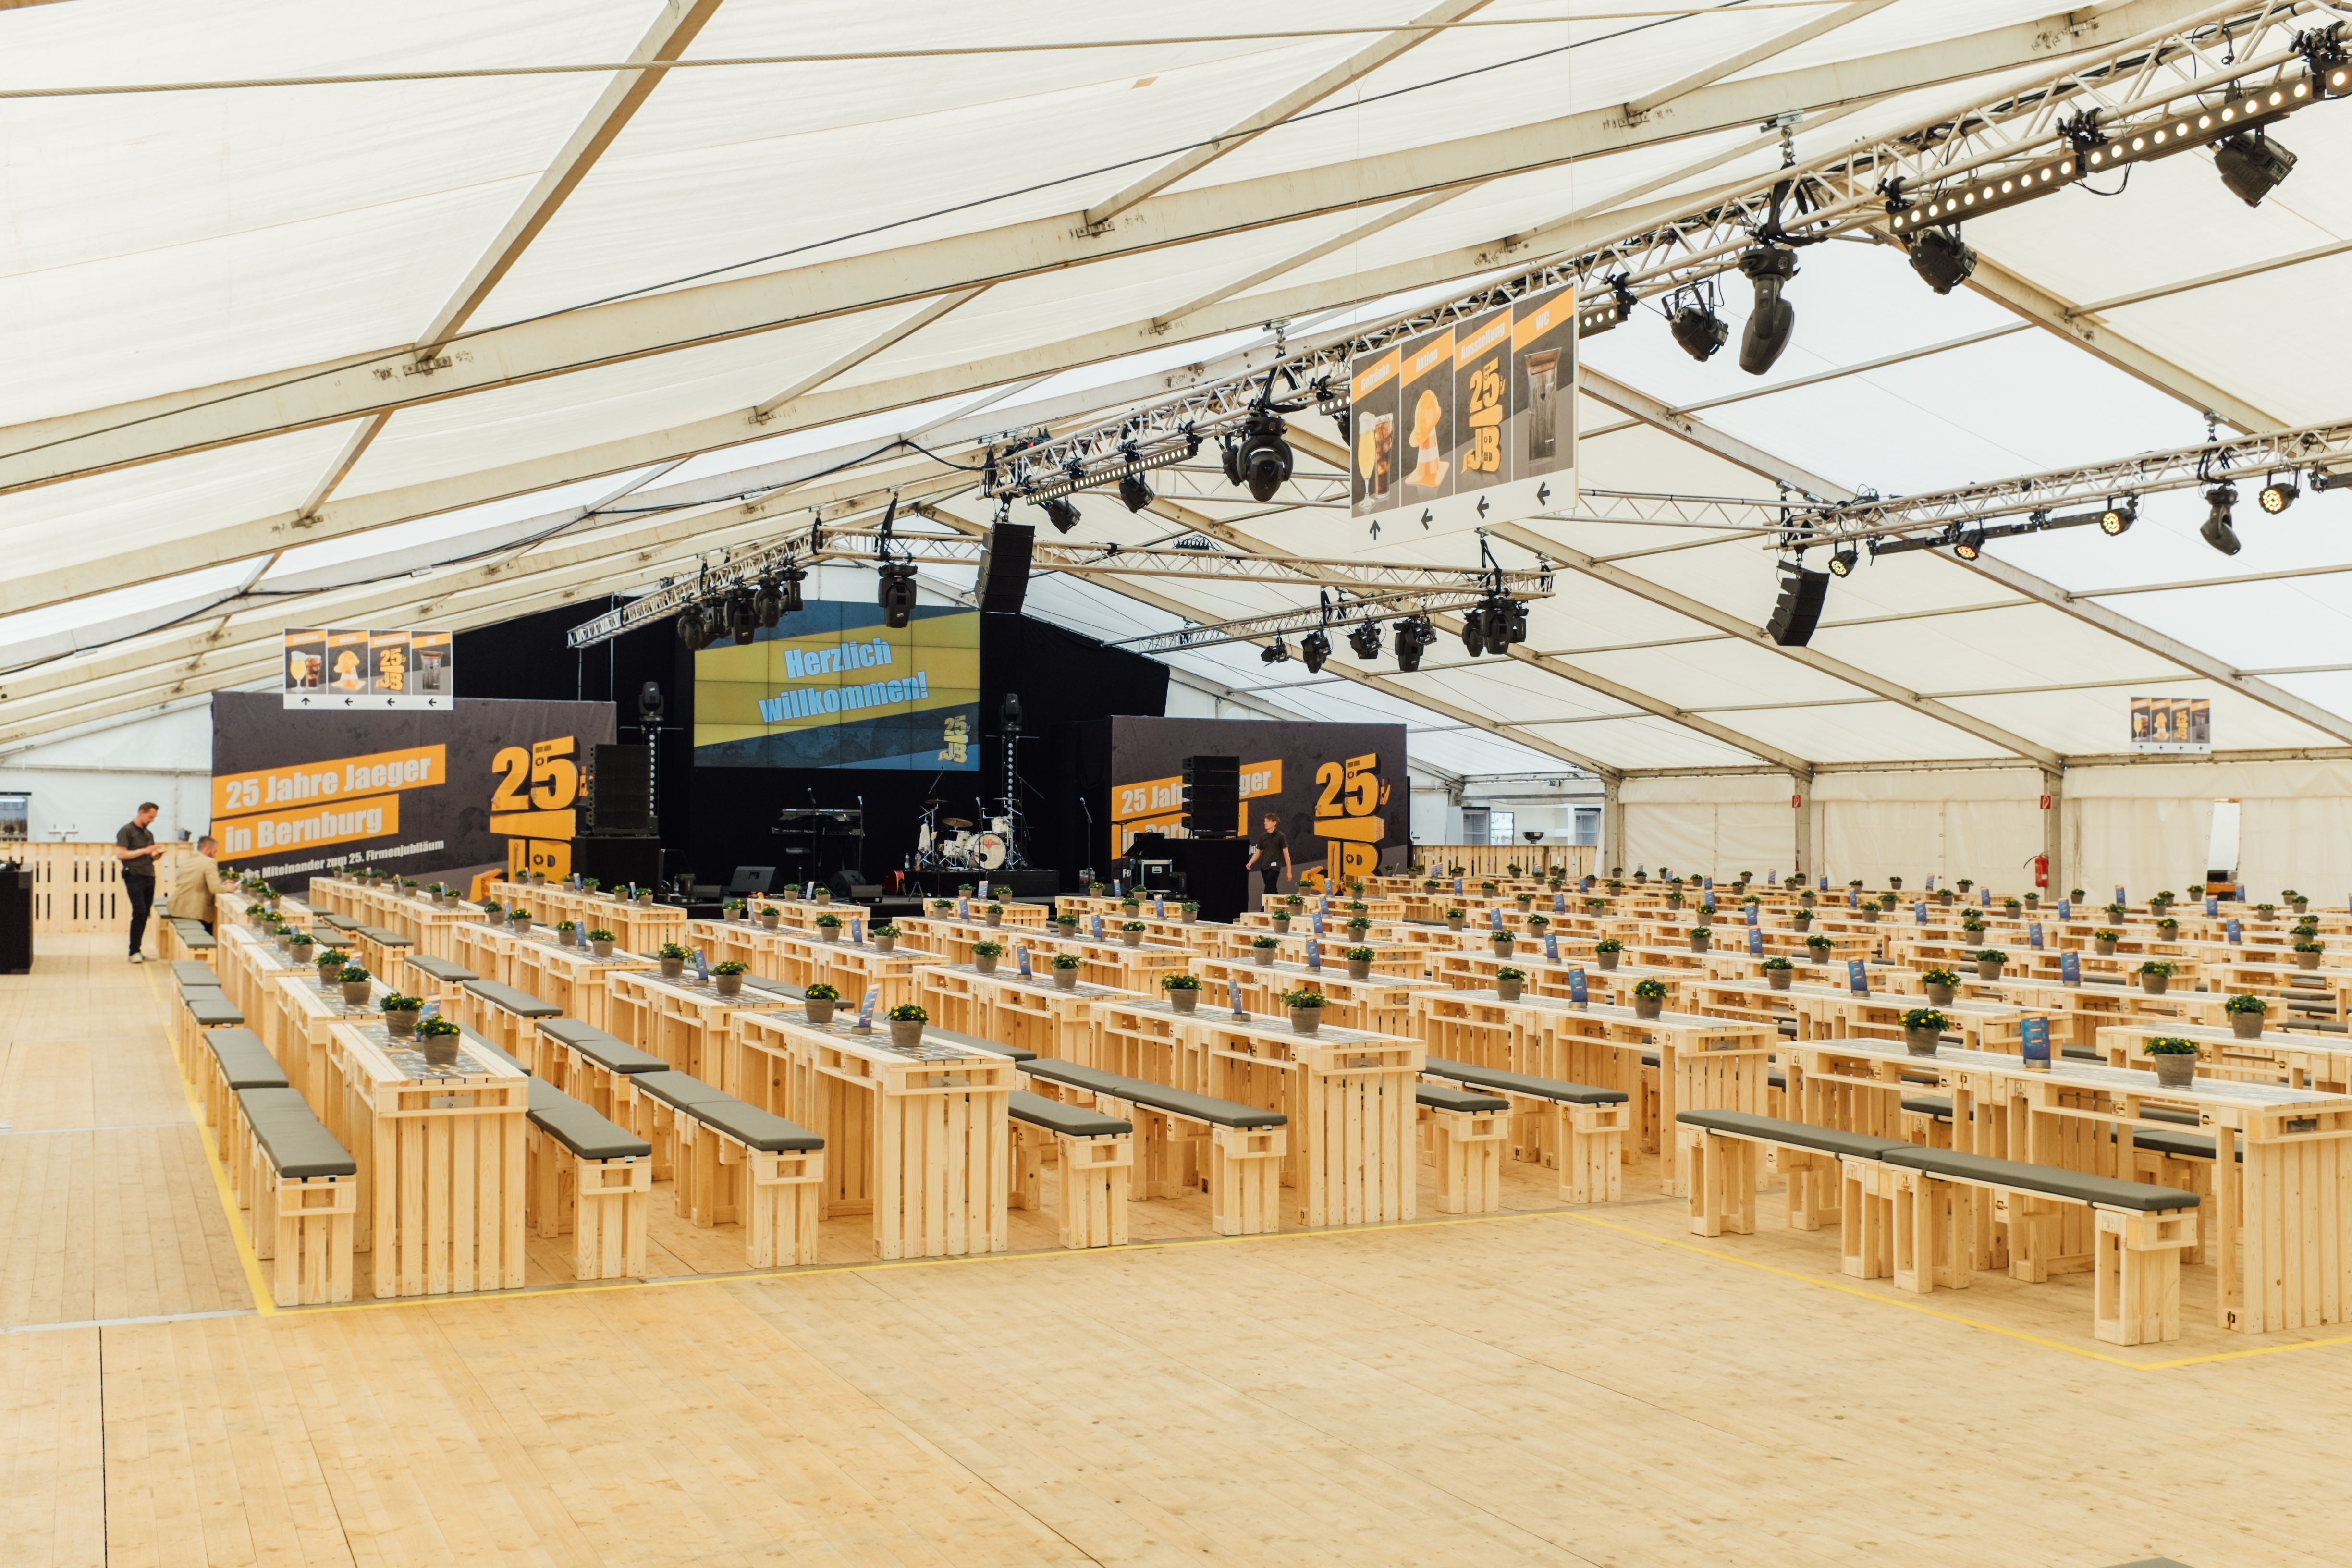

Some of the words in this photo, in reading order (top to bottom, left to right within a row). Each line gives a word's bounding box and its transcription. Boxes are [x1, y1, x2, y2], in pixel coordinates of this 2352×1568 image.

[1535, 310, 1550, 331] WC
[1415, 348, 1438, 373] Aktion
[1460, 321, 1505, 362] Ausstellung
[1360, 363, 1390, 392] Getränke
[1470, 357, 1501, 412] 25
[339, 635, 357, 643] Aktion
[380, 648, 402, 666] 25
[784, 637, 892, 679] Herzlich
[758, 671, 928, 723] willkommen!
[944, 715, 967, 735] 25
[225, 776, 260, 810] 25
[265, 766, 338, 805] Jahre
[343, 756, 431, 790] Jaeger
[491, 735, 578, 811] 25
[1121, 788, 1146, 814] 25
[1150, 783, 1193, 809] Jah
[1239, 771, 1271, 796] ger
[1314, 753, 1380, 817] 25
[225, 826, 251, 854] in
[258, 808, 382, 848] Bernburg
[262, 859, 325, 879] Miteinander
[327, 855, 347, 868] zum
[349, 852, 364, 865] 25.
[366, 840, 444, 862] Firmenjubiläum
